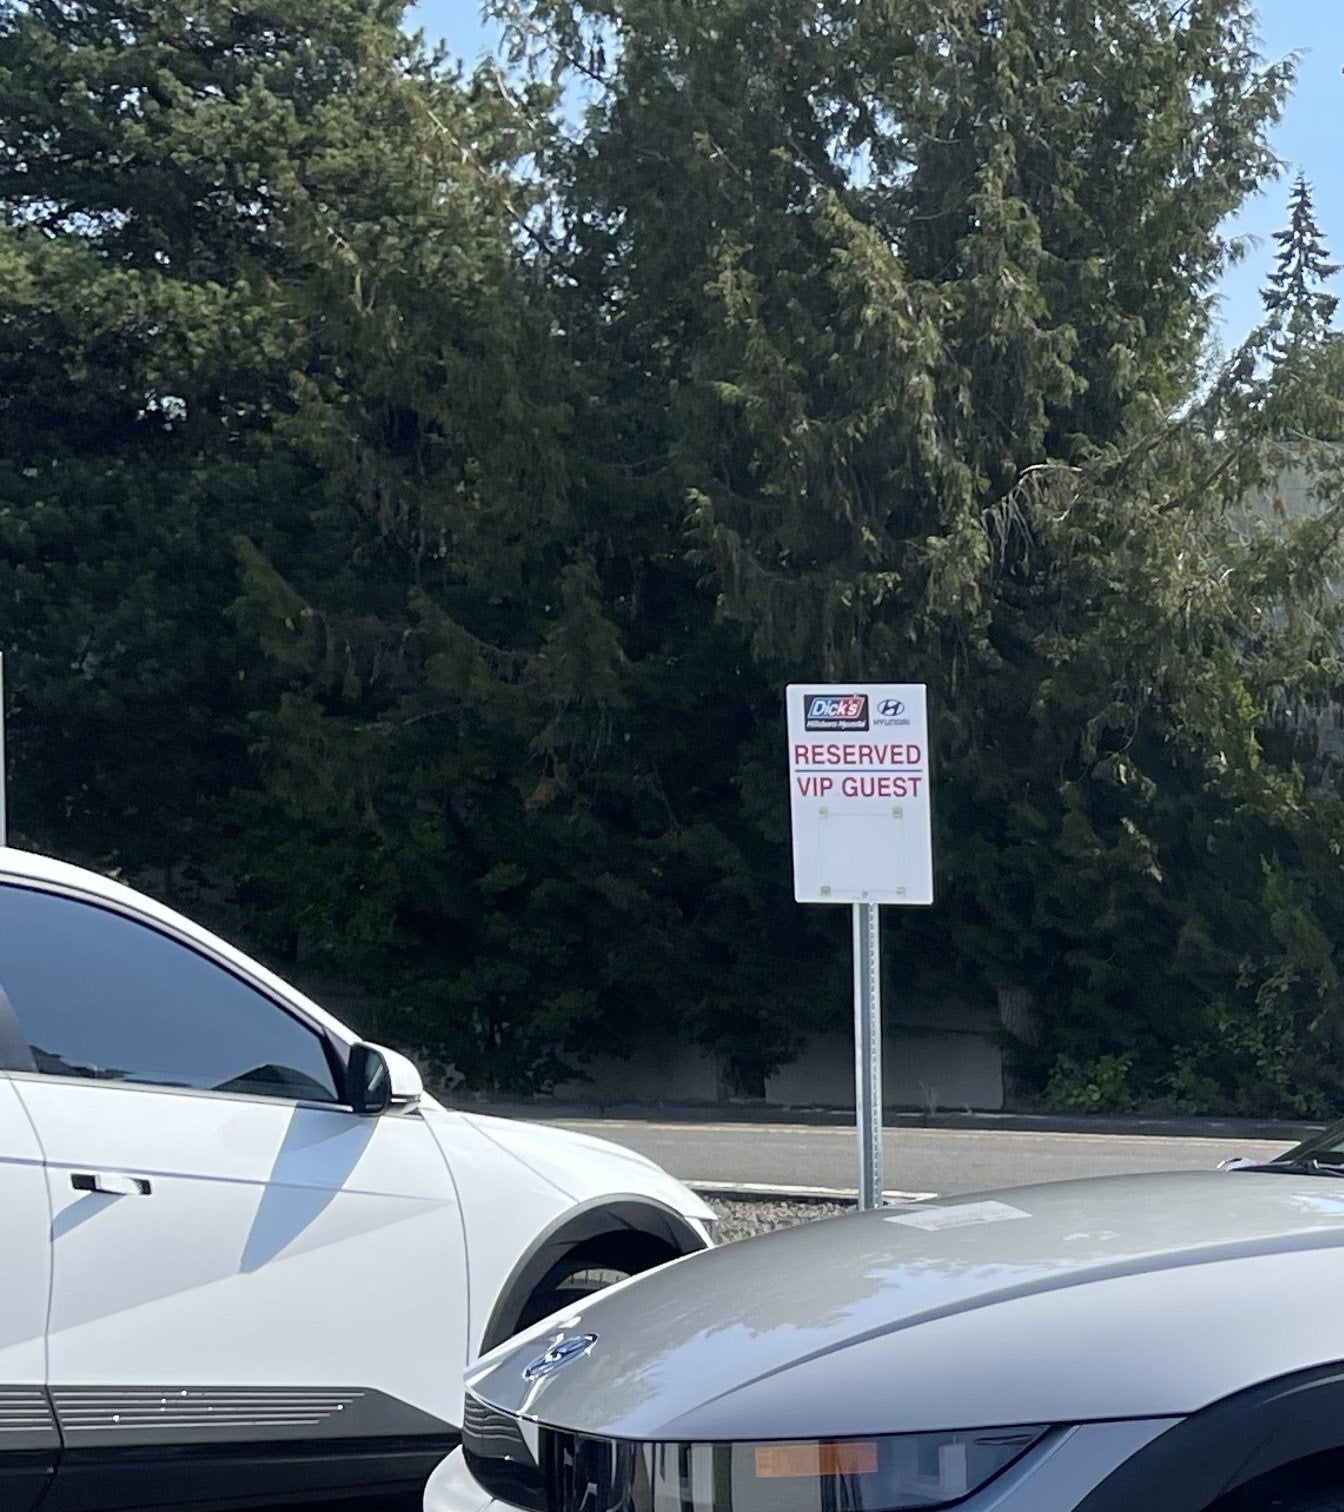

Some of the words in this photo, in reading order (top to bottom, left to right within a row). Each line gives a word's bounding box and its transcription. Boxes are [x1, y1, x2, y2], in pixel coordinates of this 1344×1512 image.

[794, 744, 922, 765] RESERVED
[797, 776, 834, 797] VIP
[841, 777, 922, 798] GUEST
